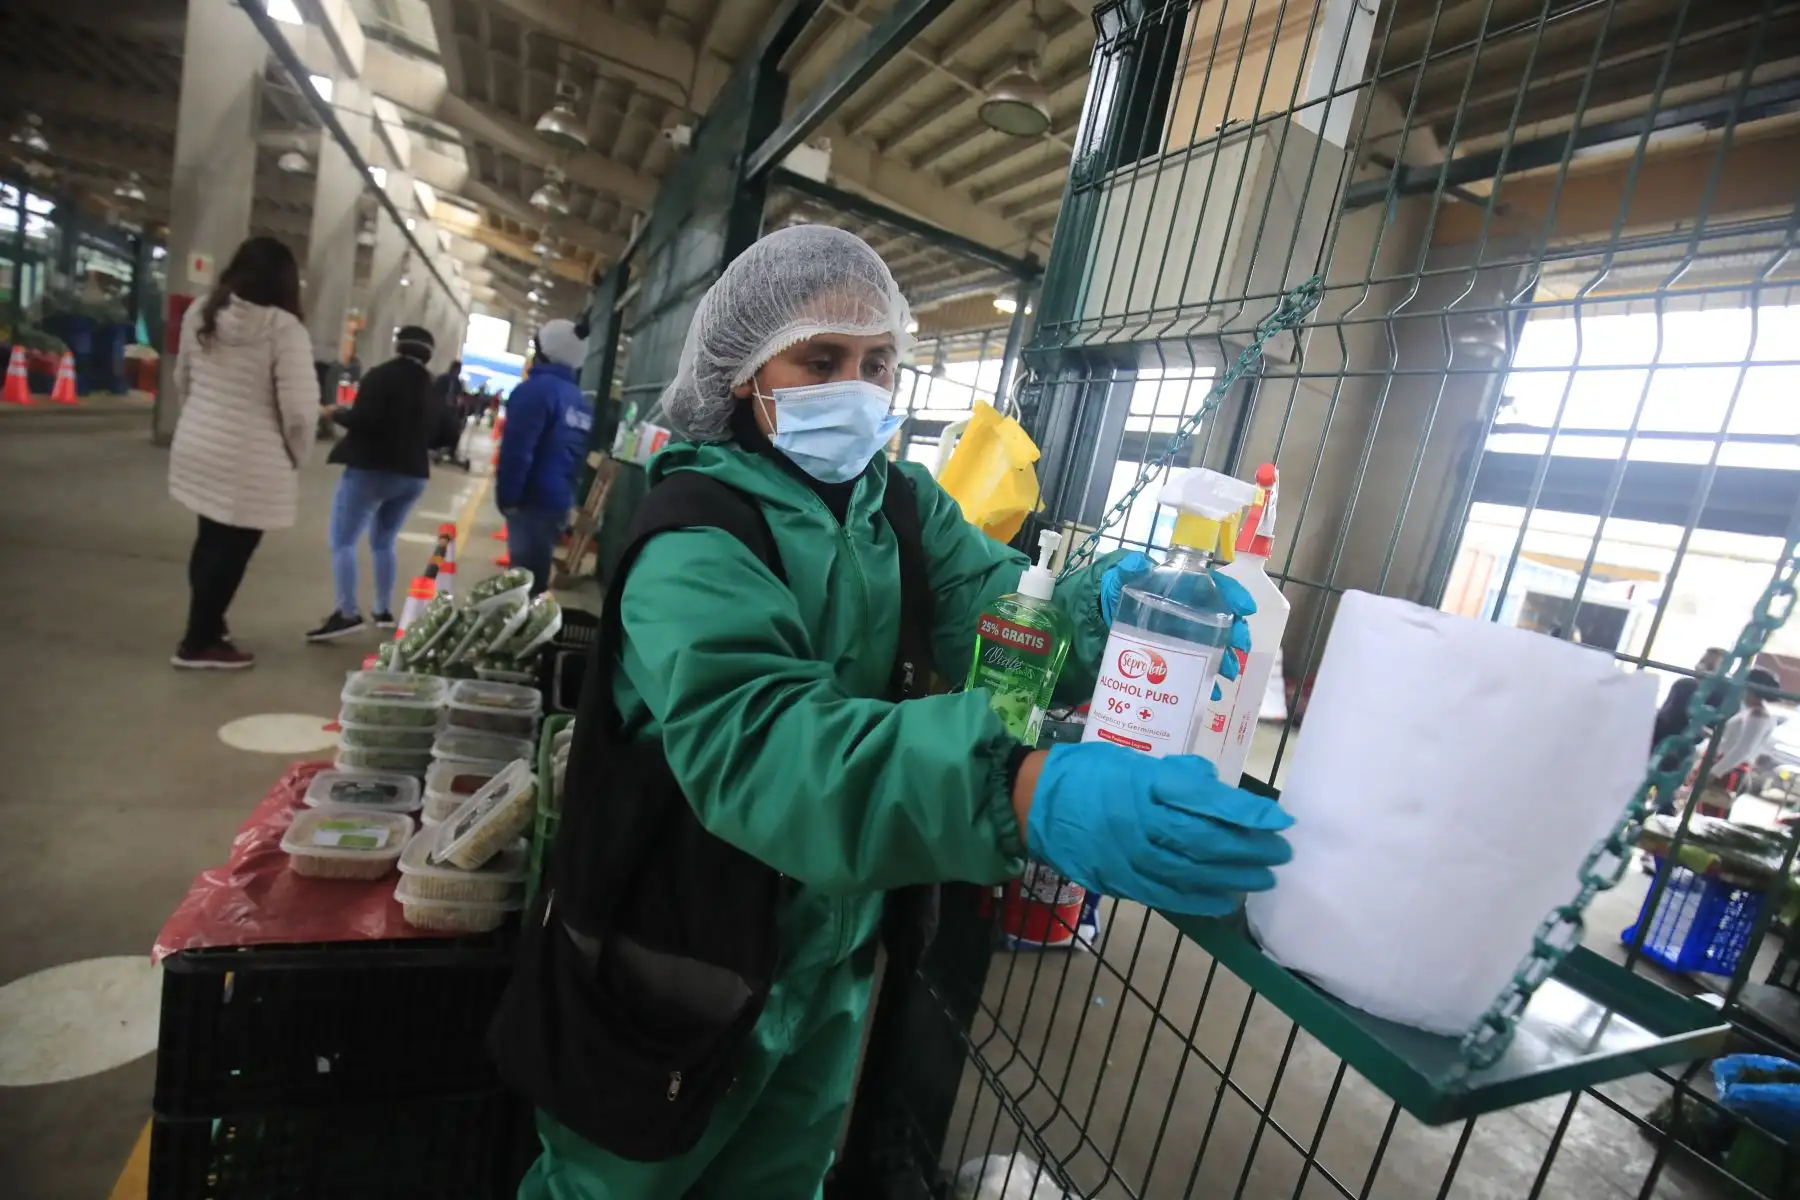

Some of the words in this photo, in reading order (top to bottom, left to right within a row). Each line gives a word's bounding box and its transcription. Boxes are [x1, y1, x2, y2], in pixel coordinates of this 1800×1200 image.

[980, 620, 1000, 636] 25%
[1001, 627, 1044, 649] GRATIS
[1100, 675, 1142, 698] ALCOHOL
[1145, 689, 1179, 705] PURO
[1107, 697, 1131, 714] 96°
